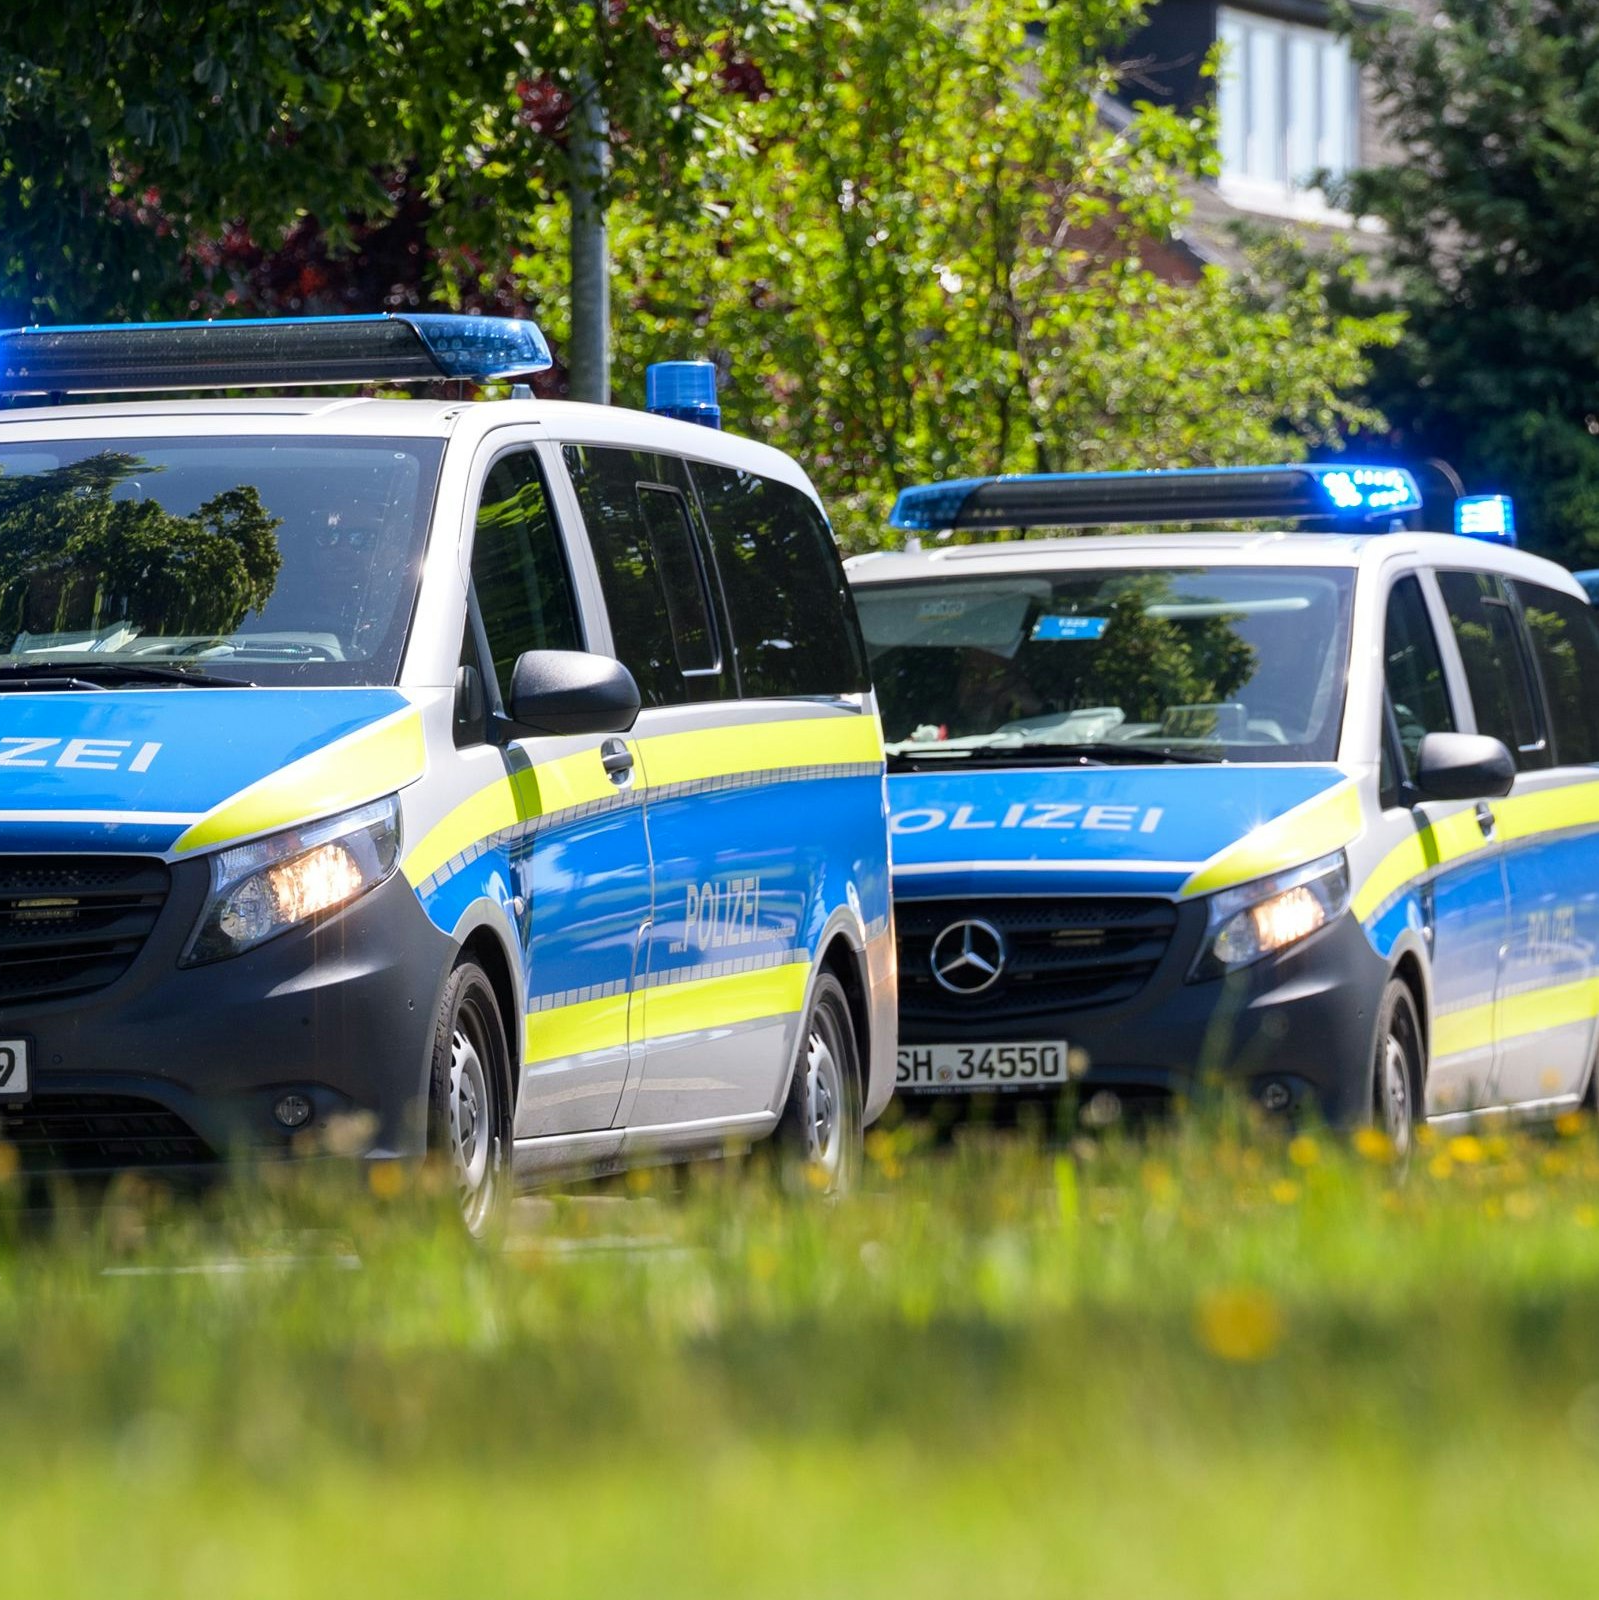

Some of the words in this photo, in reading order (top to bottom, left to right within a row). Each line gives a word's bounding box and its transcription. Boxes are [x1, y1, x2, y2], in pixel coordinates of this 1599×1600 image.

[890, 803, 1163, 834] OLIZEI
[684, 875, 760, 953] POLIZEI
[896, 1051, 933, 1082] SH
[956, 1046, 1059, 1079] 34550
